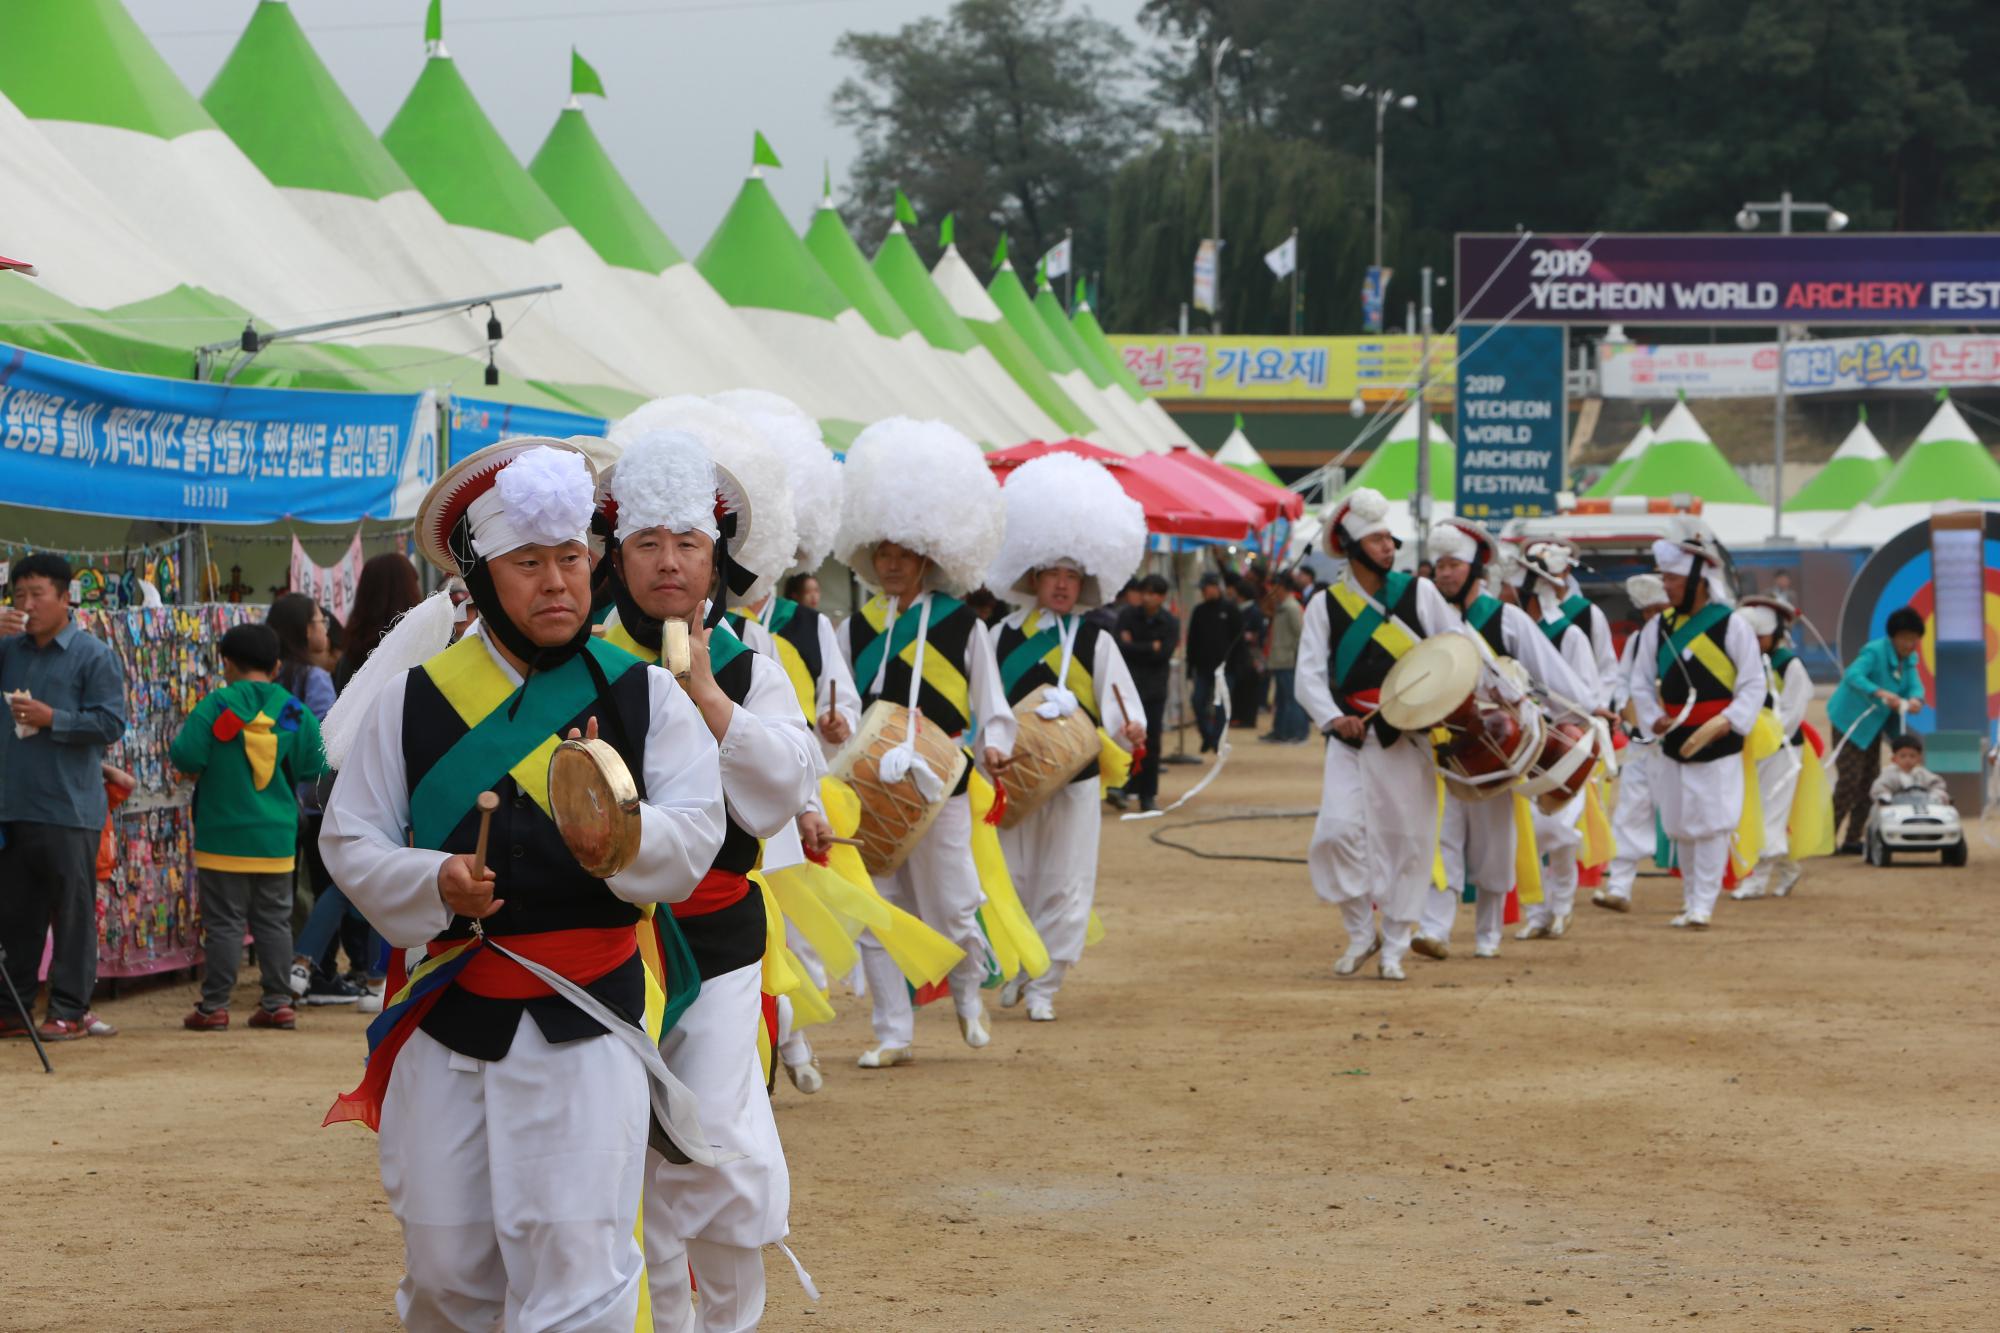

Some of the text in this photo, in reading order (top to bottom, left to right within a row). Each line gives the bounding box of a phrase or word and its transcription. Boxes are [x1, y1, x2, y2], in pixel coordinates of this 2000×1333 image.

[1530, 249, 1592, 277] 2019
[1530, 282, 2000, 310] YECHEON WORLD ARCHERY FEST
[1123, 343, 1331, 391] 전국 가요제
[1838, 340, 1925, 386] 어르신
[1464, 374, 1506, 394] 2019
[1464, 401, 1552, 419] YECHEON
[1464, 425, 1532, 444] WORLD
[1463, 450, 1552, 469] ARCHERY
[1463, 475, 1549, 494] FESTIVAL
